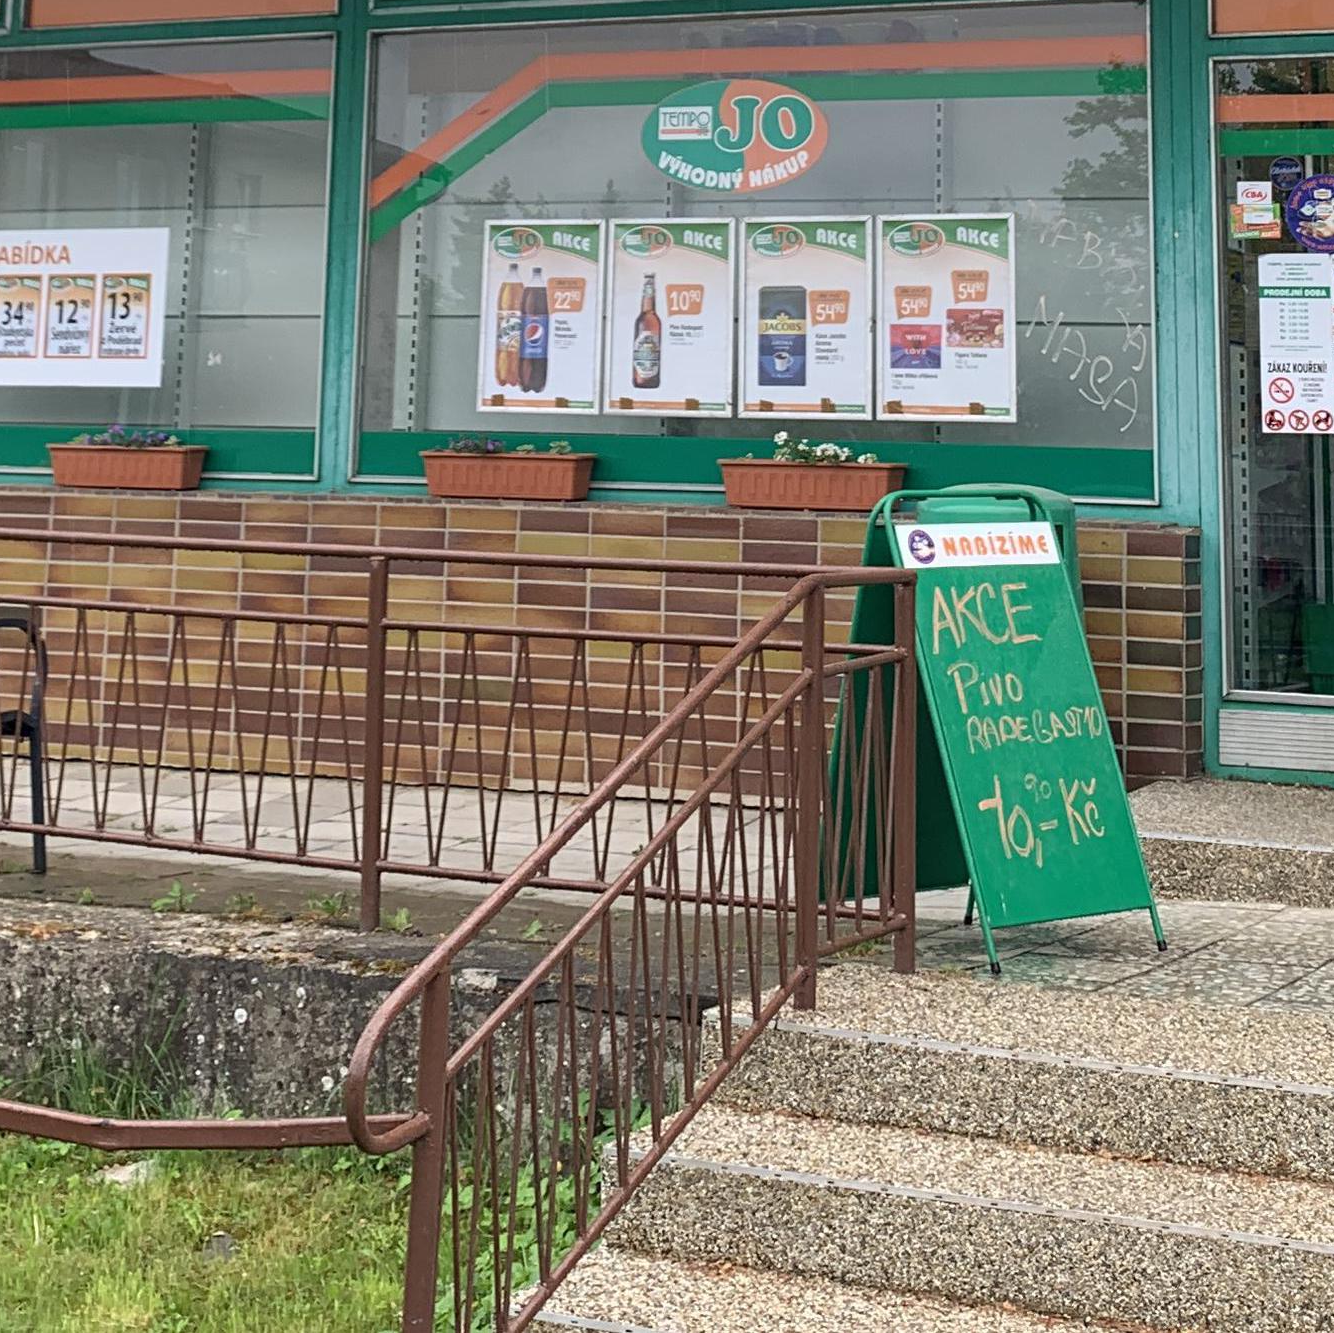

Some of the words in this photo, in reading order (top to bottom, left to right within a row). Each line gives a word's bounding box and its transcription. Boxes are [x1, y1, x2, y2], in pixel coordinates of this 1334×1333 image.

[661, 111, 710, 127] TEMPO
[714, 94, 815, 153] JO
[658, 151, 743, 190] VÝHODNÝ
[749, 150, 809, 188] NÁKUP
[552, 231, 591, 252] AKCE
[683, 229, 723, 250] AKCE
[816, 228, 857, 249] AKCE
[956, 226, 999, 248] AKCE
[1263, 287, 1304, 297] PRODEJNÍ
[1304, 289, 1327, 297] DOBA
[763, 322, 802, 332] JACOBS
[1267, 360, 1291, 373] ZÁKAZ
[942, 531, 1050, 556] NABÍZÍME
[931, 581, 1042, 655] AKCE
[1059, 777, 1105, 846] Kč
